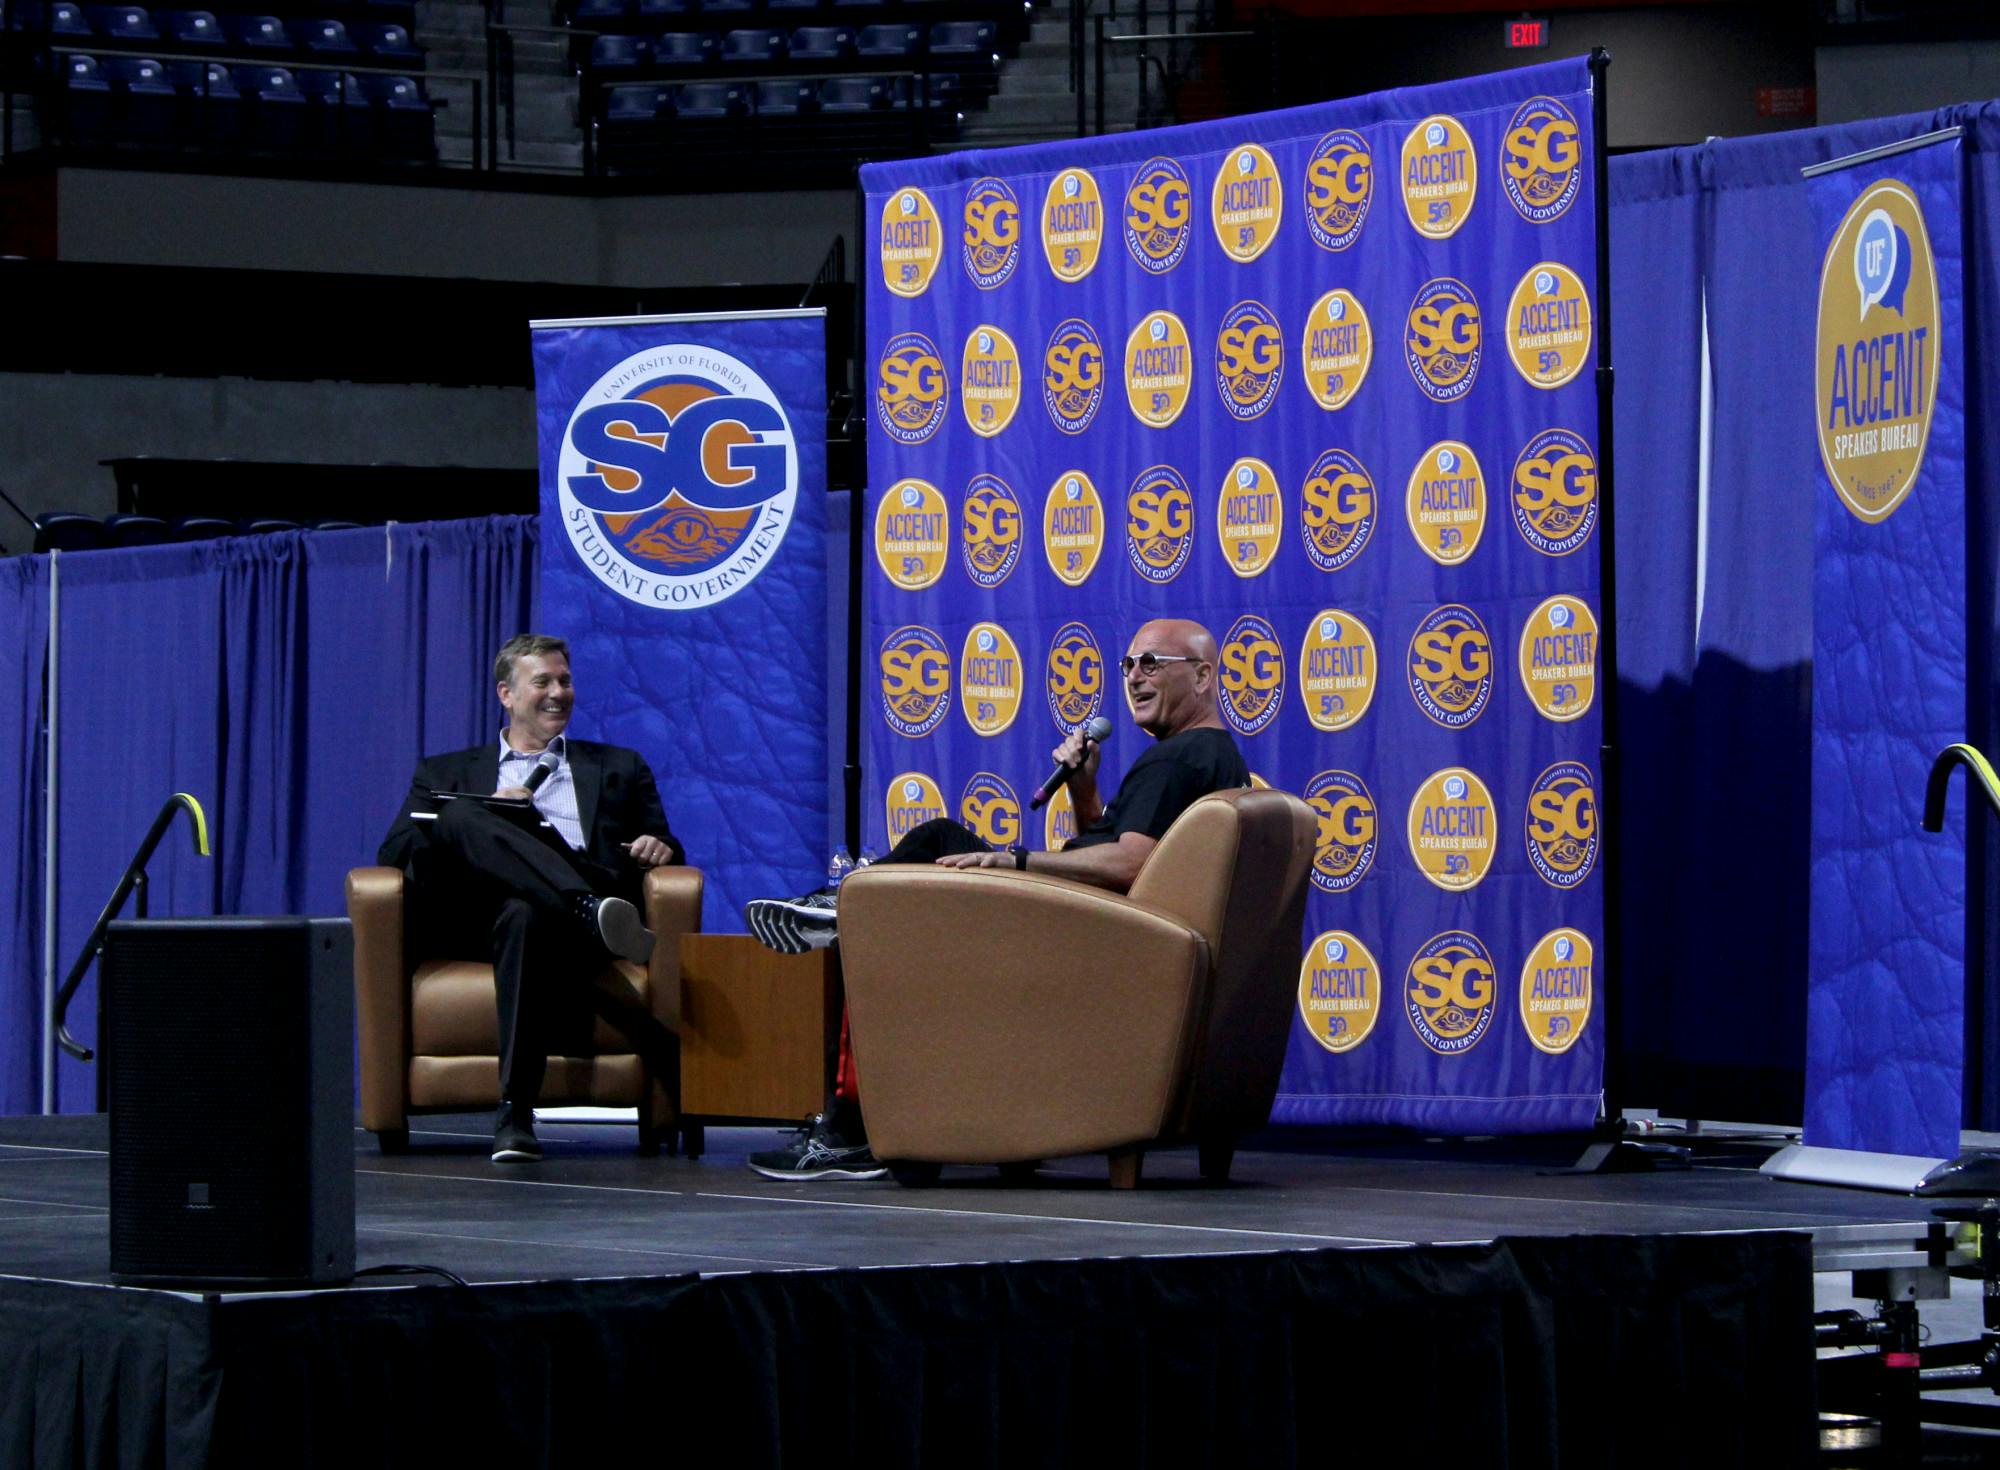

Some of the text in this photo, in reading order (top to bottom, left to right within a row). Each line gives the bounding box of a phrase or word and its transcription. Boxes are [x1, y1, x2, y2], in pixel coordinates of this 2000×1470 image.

[1511, 23, 1541, 47] EXIT
[1408, 150, 1465, 186] ACCENT
[1505, 120, 1579, 180] SG
[1222, 178, 1272, 213] ACCENT
[1308, 152, 1371, 208] SG
[1408, 186, 1444, 198] SPEAKERS
[1507, 168, 1579, 218] STUDENT GOVERNMENT
[964, 199, 1018, 247] SG
[1050, 201, 1096, 232] ACCENT
[1127, 179, 1189, 232] SG
[1222, 212, 1249, 224] SPEAKERS
[1308, 199, 1367, 247] STUDENT GOVERNMENT
[1128, 224, 1189, 270] STUDENT GOVERNMENT
[1865, 239, 1885, 278] UF
[1409, 302, 1479, 356] SG
[1518, 298, 1580, 336] ACCENT
[1219, 324, 1280, 376] SG
[1311, 324, 1360, 359] ACCENT
[1518, 331, 1583, 349] SPEAKERS BUREAU
[603, 354, 748, 400] UNIVERSITY OF FLORIDA
[879, 356, 943, 402] SG
[966, 360, 1012, 387] ACCENT
[1045, 342, 1100, 392] SG
[1132, 346, 1184, 378] ACCENT
[1132, 375, 1184, 388] SPEAKERS BUREAU
[1311, 359, 1338, 371] SPEAKERS
[1410, 351, 1479, 397] STUDENT GOVERNMENT
[1828, 327, 1927, 430] ACCENT
[988, 388, 1012, 398] BUREAU
[1046, 388, 1100, 429] STUDENT GOVERNMENT
[1239, 371, 1279, 415] GOVERNMENT
[880, 399, 944, 439] STUDENT GOVERNMENT
[566, 396, 788, 515] SG
[1834, 423, 1918, 460] SPEAKERS BUREAU
[1303, 472, 1371, 527] SG
[1420, 478, 1476, 510] ACCENT
[1515, 453, 1596, 511] SG
[1856, 478, 1876, 500] SINCE
[884, 513, 943, 540] ACCENT
[963, 497, 1018, 544] SG
[1051, 505, 1094, 535] ACCENT
[1128, 489, 1190, 539] SG
[1226, 494, 1274, 525] ACCENT
[1420, 510, 1478, 523] SPEAKERS BUREAU
[1517, 502, 1596, 551] STUDENT GOVERNMENT
[884, 542, 943, 552] SPEAKERS BUREAU
[1252, 524, 1274, 536] BUREAU
[1304, 519, 1369, 566] STUDENT GOVERNMENT
[569, 501, 785, 603] STUDENT GOVERNMENT
[1128, 536, 1150, 577] STUDENT
[1221, 640, 1280, 690] SG
[1308, 645, 1365, 678] ACCENT
[1412, 630, 1490, 682] SG
[1532, 632, 1592, 667] ACCENT
[881, 649, 949, 696] SG
[967, 658, 1013, 687] ACCENT
[1050, 647, 1100, 695] SG
[1336, 677, 1367, 688] BUREAU
[1532, 667, 1566, 680] SPEAKERS
[990, 688, 1014, 698] BUREAU
[1051, 692, 1067, 731] STUDENT
[1220, 689, 1243, 729] STUDENT
[1414, 677, 1489, 723] STUDENT GOVERNMENT
[905, 694, 949, 734] GOVERNMENT
[1450, 782, 1460, 791] UF
[963, 795, 1019, 845] SG
[1420, 806, 1486, 835] ACCENT
[1528, 787, 1594, 841] SG
[1420, 838, 1458, 848] SPEAKERS
[1529, 840, 1557, 879] STUDENT
[1326, 843, 1373, 887] GOVERNMENT
[1311, 968, 1367, 998] ACCENT
[1410, 956, 1492, 1010] SG
[1532, 966, 1588, 999] ACCENT
[1411, 1004, 1490, 1050] STUDENT GOVERNMENT
